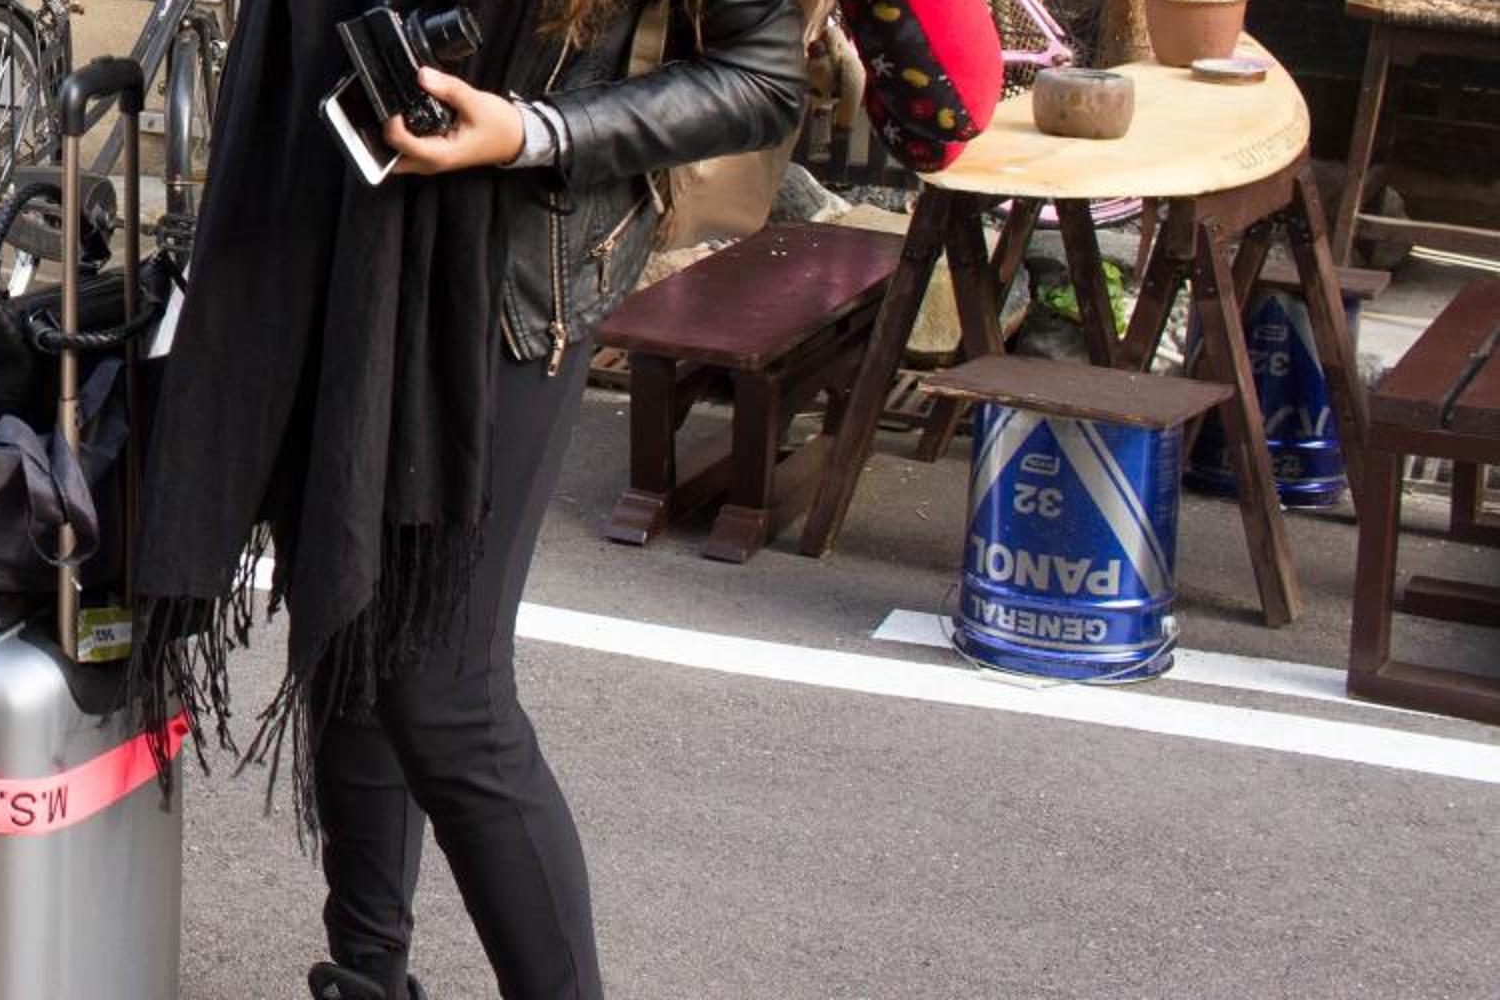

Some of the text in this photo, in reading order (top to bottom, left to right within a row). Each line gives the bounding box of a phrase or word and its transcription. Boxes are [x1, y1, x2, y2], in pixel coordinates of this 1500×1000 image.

[1014, 482, 1063, 517] 32
[970, 535, 1121, 596] PANOL
[972, 596, 1107, 642] GENERAL
[0, 783, 68, 827] M.S.
